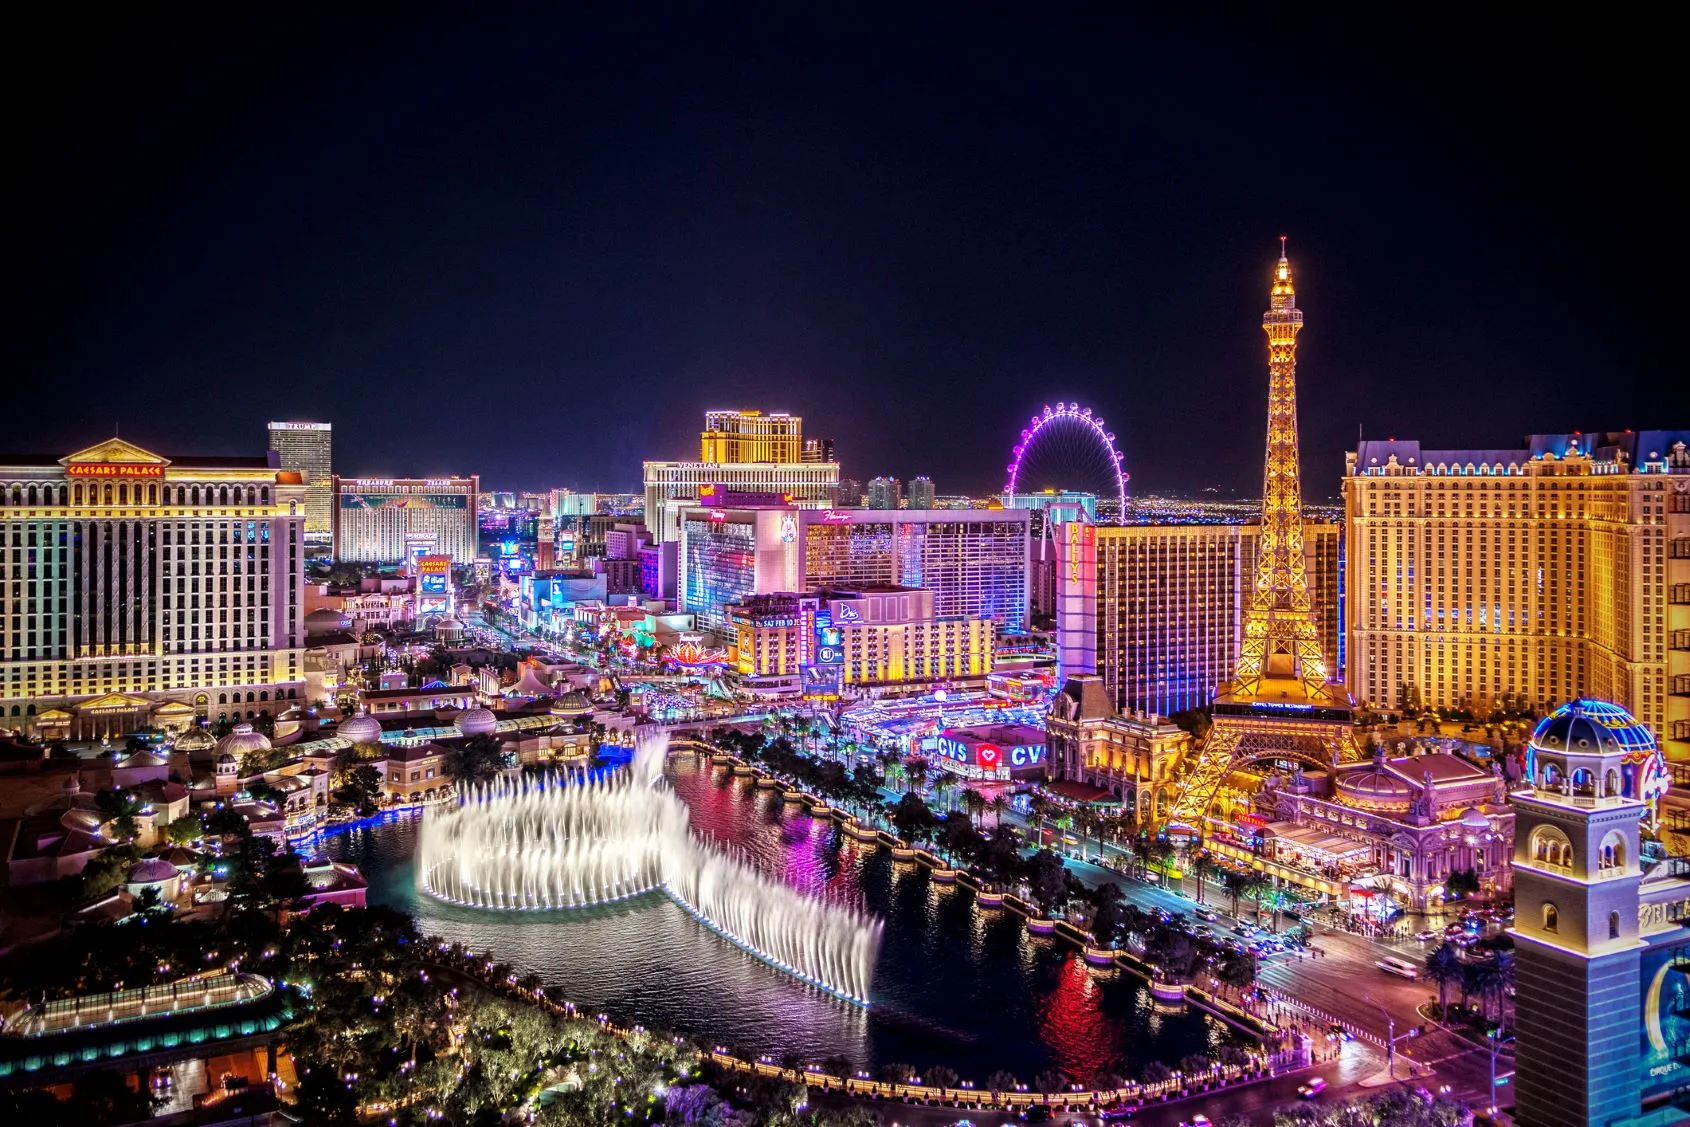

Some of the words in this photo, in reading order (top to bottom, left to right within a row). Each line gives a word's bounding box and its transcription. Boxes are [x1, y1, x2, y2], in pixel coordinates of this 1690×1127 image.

[69, 466, 116, 475] CAESARS
[120, 466, 161, 475] PALACE
[938, 738, 967, 762] CVS
[1011, 745, 1046, 766] CV
